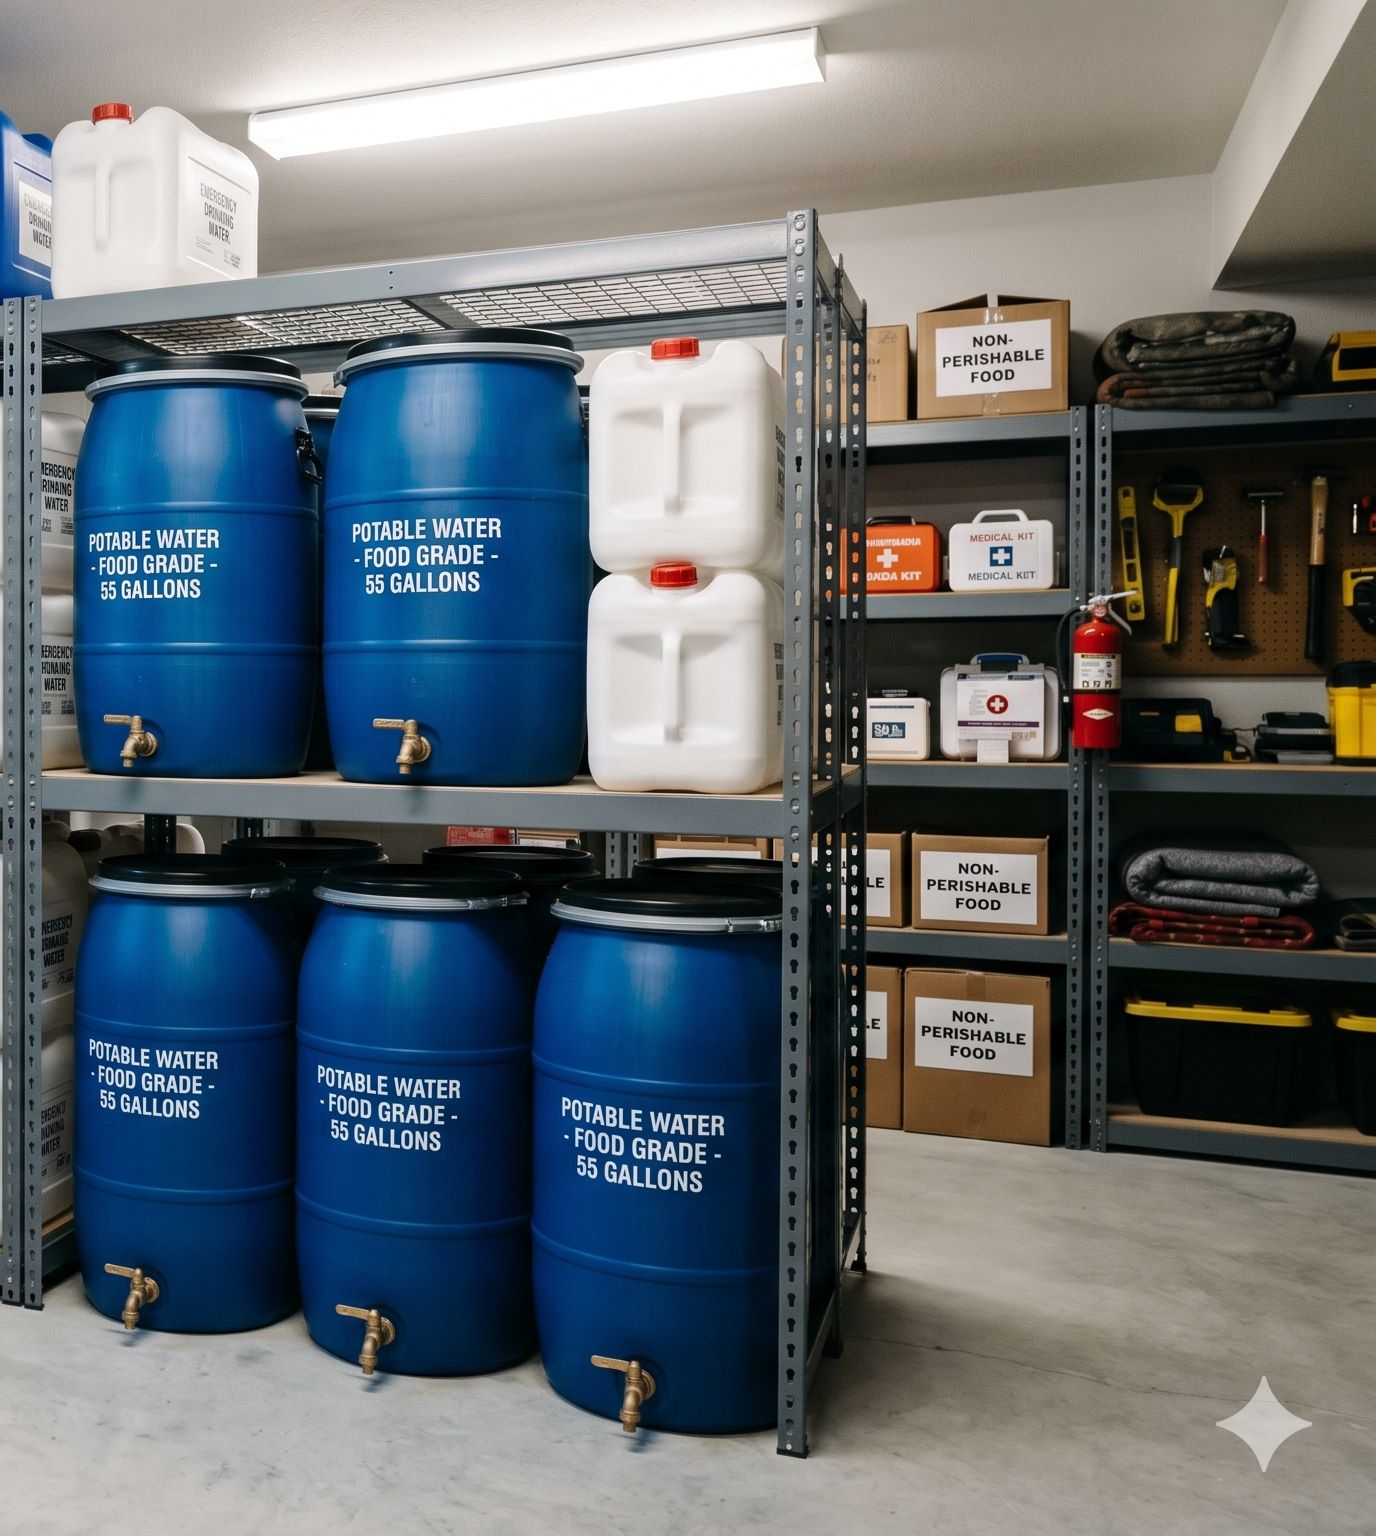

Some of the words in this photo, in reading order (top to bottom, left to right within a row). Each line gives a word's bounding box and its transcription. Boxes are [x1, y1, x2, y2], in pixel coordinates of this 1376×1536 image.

[972, 333, 1013, 348] NON-
[942, 349, 1045, 368] PERISHABLE
[970, 369, 1015, 383] FOOD
[45, 496, 69, 512] WATER
[89, 529, 152, 553] POTABLE
[156, 528, 220, 549] WATER
[352, 518, 427, 543] POTABLE
[431, 517, 502, 539] WATER
[969, 533, 1014, 543] MEDICAL
[1018, 532, 1034, 540] KIT
[99, 555, 138, 576] FOOD
[142, 553, 205, 575] GRADE
[364, 546, 411, 568] FOOD
[416, 544, 484, 567] GRADE
[365, 573, 385, 595] 55
[389, 570, 481, 594] GALLONS
[901, 571, 922, 581] KIT
[968, 572, 1013, 581] MEDICAL
[100, 580, 117, 601] 55
[120, 578, 201, 600] GALLONS
[44, 677, 66, 691] WATER
[958, 863, 999, 875] NON-
[926, 879, 1031, 895] PERISHABLE
[955, 897, 1001, 911] FOOD
[952, 1010, 995, 1024] NON-
[921, 1025, 1026, 1045] PERISHABLE
[89, 1038, 150, 1068] POTABLE
[155, 1049, 219, 1070] WATER
[950, 1045, 996, 1060] FOOD
[98, 1064, 136, 1090] FOOD
[141, 1072, 203, 1095] GRADE
[317, 1064, 389, 1096] POTABLE
[393, 1076, 461, 1099] WATER
[99, 1089, 117, 1110] 55
[120, 1093, 200, 1120] GALLONS
[328, 1092, 372, 1119] FOOD
[377, 1101, 445, 1125] GRADE
[561, 1096, 643, 1132] POTABLE
[649, 1111, 725, 1136] WATER
[330, 1118, 349, 1142] 55
[353, 1123, 442, 1152] GALLONS
[574, 1127, 625, 1156] FOOD
[631, 1137, 707, 1165] GRADE
[576, 1154, 598, 1179] 55
[604, 1161, 704, 1193] GALLONS
